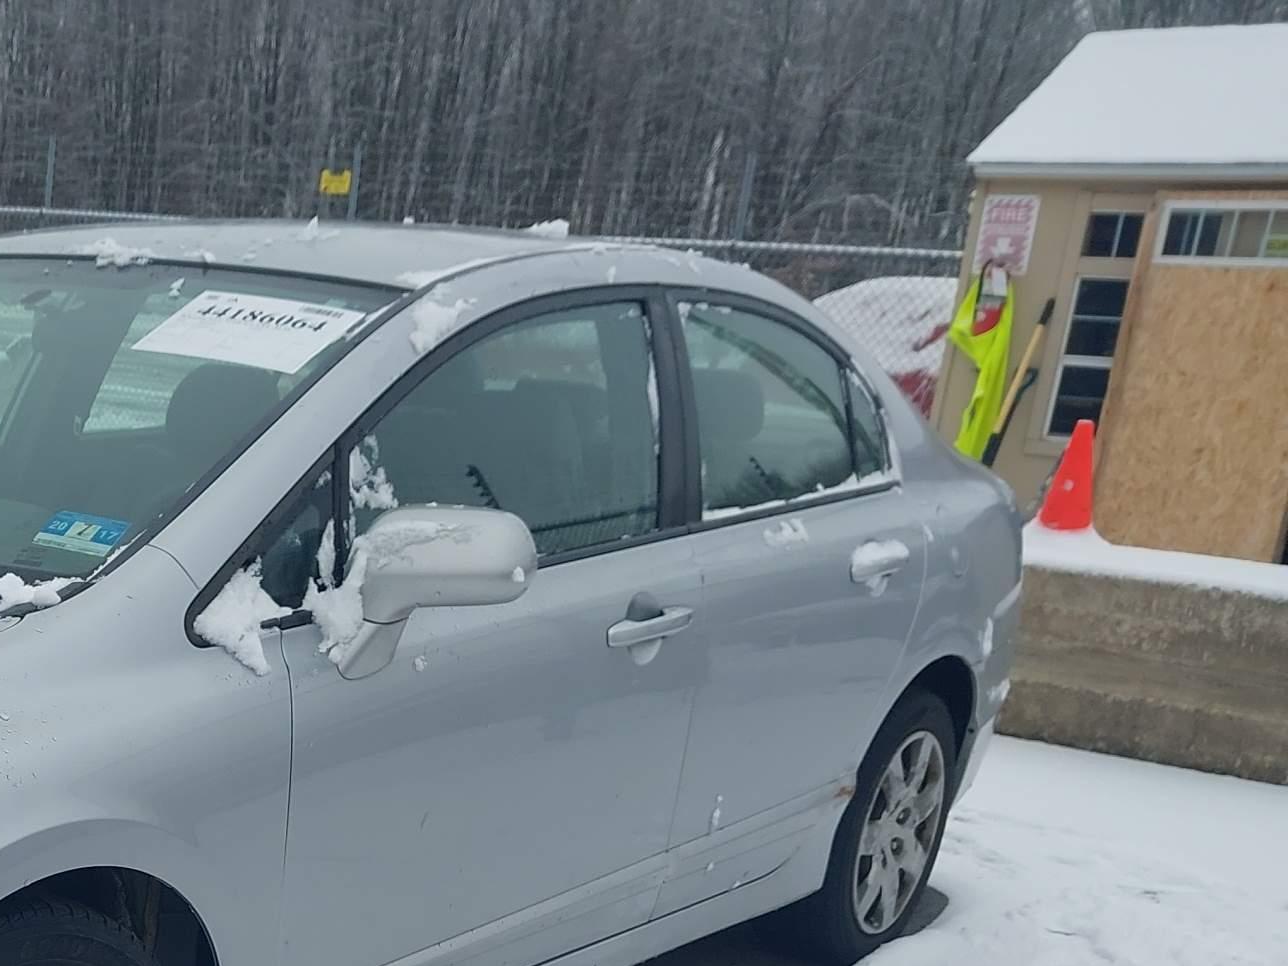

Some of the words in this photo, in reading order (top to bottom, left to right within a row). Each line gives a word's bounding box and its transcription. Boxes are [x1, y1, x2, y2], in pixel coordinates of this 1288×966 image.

[991, 207, 1029, 222] FIRE
[197, 304, 328, 331] 44186064
[48, 520, 68, 531] 20
[99, 529, 119, 541] 17
